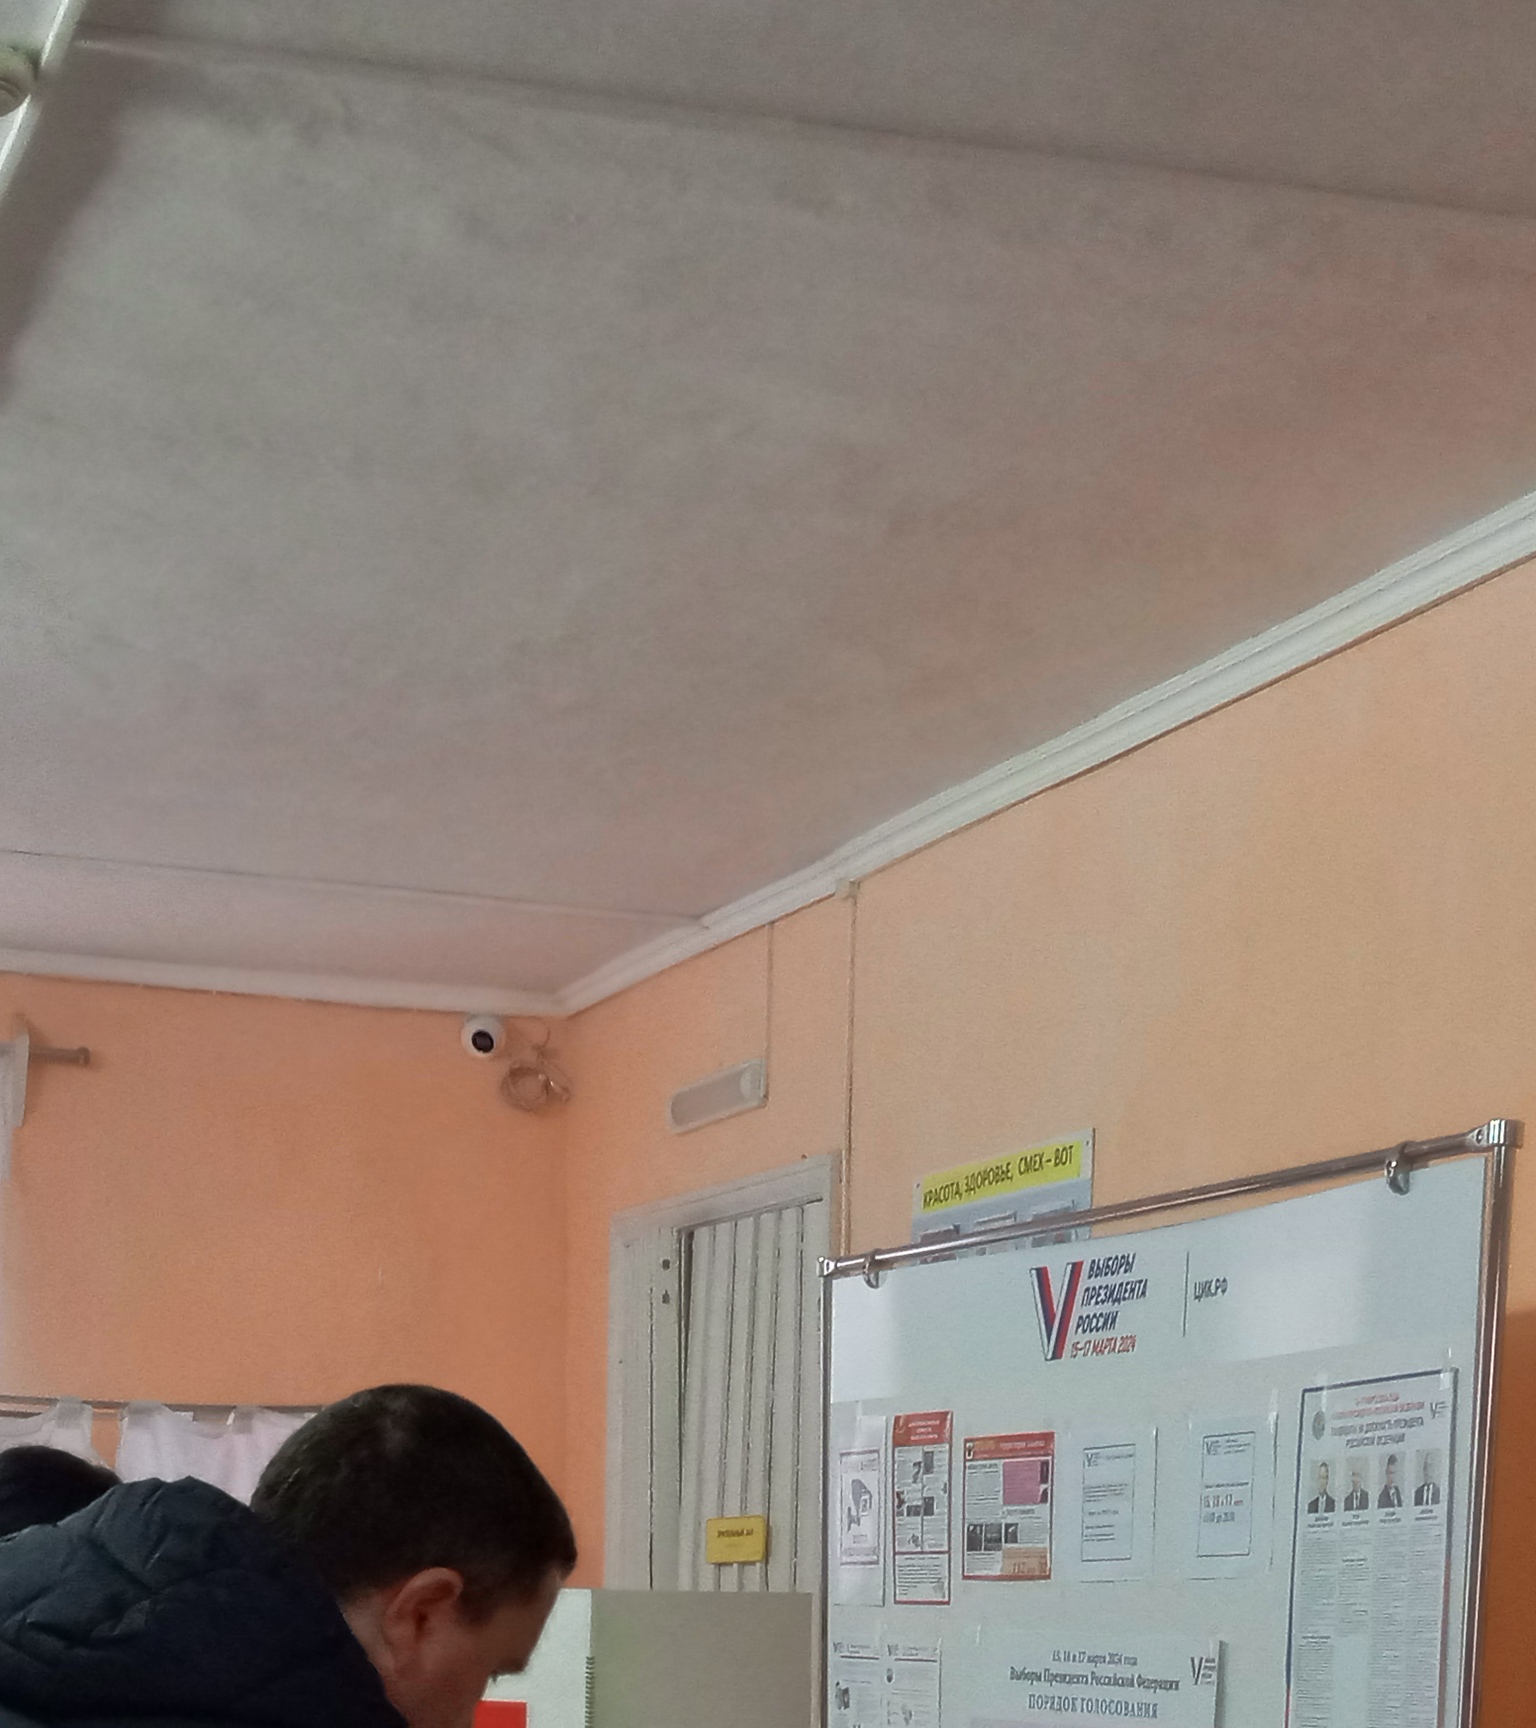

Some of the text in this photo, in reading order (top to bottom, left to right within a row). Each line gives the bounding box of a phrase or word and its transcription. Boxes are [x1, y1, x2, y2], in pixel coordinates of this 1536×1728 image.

[1053, 1145, 1075, 1167] ВОТ
[1087, 1253, 1137, 1281] ВЫБОРЫ
[1080, 1278, 1149, 1308] ПРЕЗИДЕНТА
[1193, 1276, 1229, 1302] ЦИК.РФ
[1074, 1310, 1120, 1335] РОССИИ
[1028, 1693, 1159, 1719] ПОРЯДОК ГОЛОСОВАНИЯ
